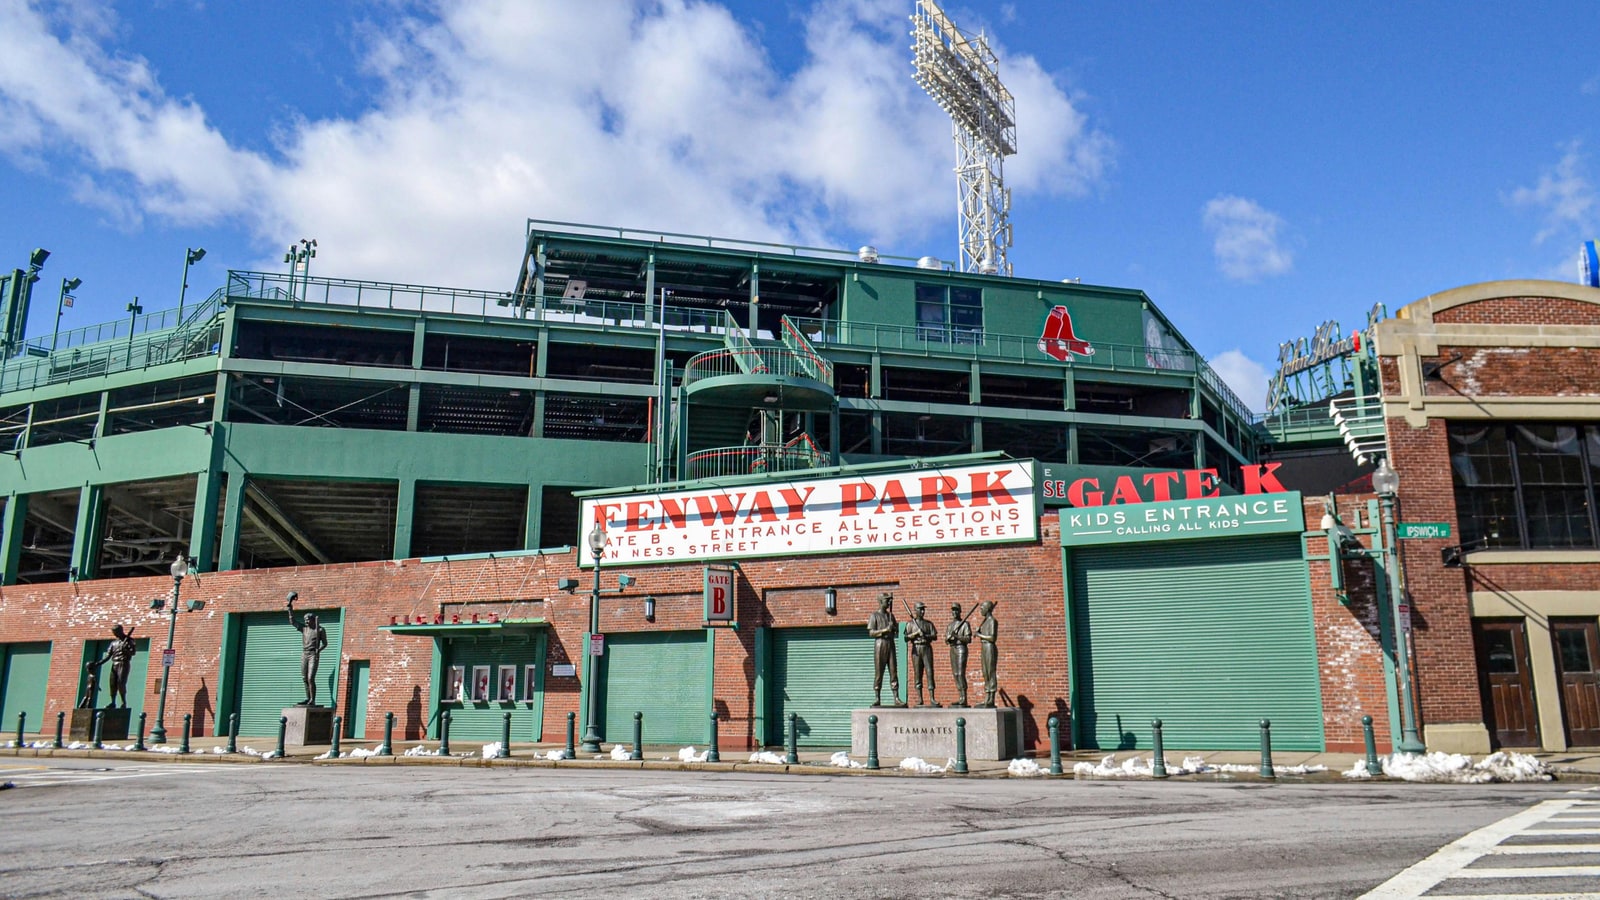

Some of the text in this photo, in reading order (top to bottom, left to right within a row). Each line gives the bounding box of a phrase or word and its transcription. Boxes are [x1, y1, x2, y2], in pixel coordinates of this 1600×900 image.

[1308, 301, 1381, 366] Hanck
[1067, 462, 1288, 508] GATE K
[593, 470, 1018, 533] FENWAY PARK
[1071, 500, 1288, 527] KIDS ENTRANCE
[605, 508, 1020, 547] ATE B ENTRANCE ALL SECTIONS
[1116, 519, 1240, 535] CALLING ALL KIDS
[1406, 526, 1439, 538] IPSWICH
[632, 546, 675, 558] NESS
[689, 541, 758, 554] STREET
[830, 531, 918, 545] IPSWICH
[936, 524, 1020, 539] STREET
[708, 575, 730, 585] GATE
[713, 587, 726, 614] B
[893, 726, 953, 735] TEAMMATES
